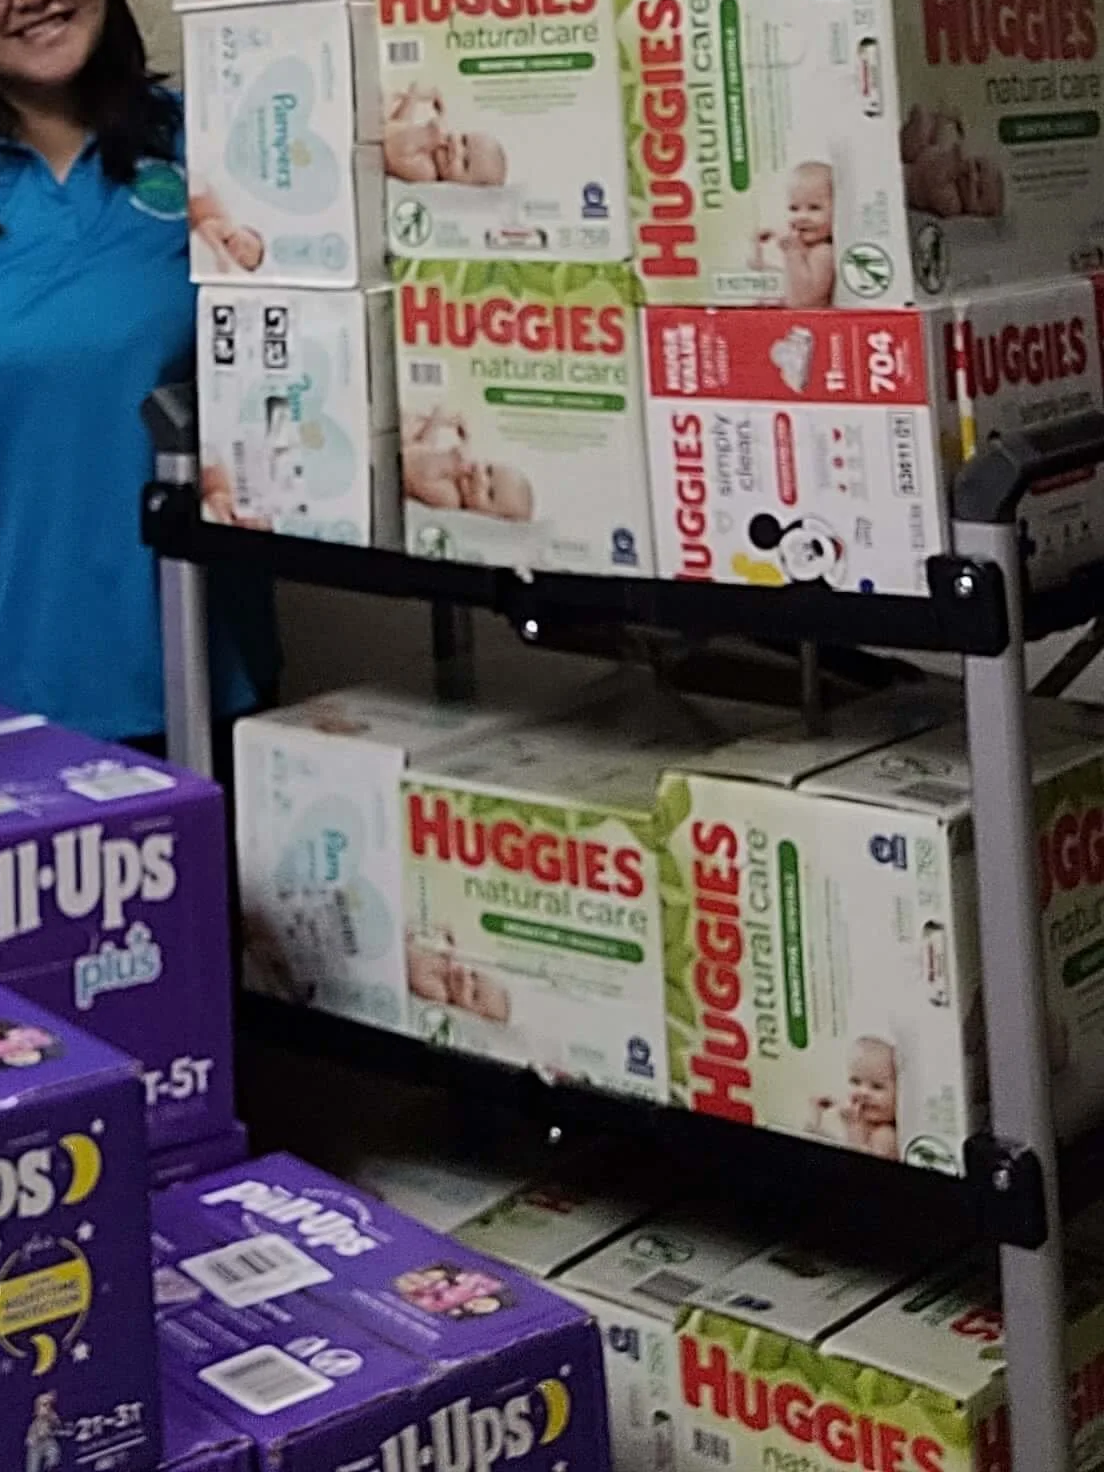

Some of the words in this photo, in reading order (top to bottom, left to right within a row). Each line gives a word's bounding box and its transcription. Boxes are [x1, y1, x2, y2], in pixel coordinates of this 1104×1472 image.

[446, 22, 536, 50] natural
[540, 24, 600, 46] care
[689, 88, 724, 212] natural
[401, 284, 627, 357] HUGGIES
[943, 316, 1089, 402] HUGGIES
[470, 356, 563, 379] natural
[567, 360, 627, 383] care
[867, 329, 898, 395] 704
[407, 793, 646, 899] HUGGIES
[746, 828, 772, 918] care
[464, 873, 570, 917] natural
[576, 896, 649, 936] care
[78, 941, 160, 1006] plus
[689, 818, 754, 1127] HUGGIES
[741, 921, 780, 1060] natural
